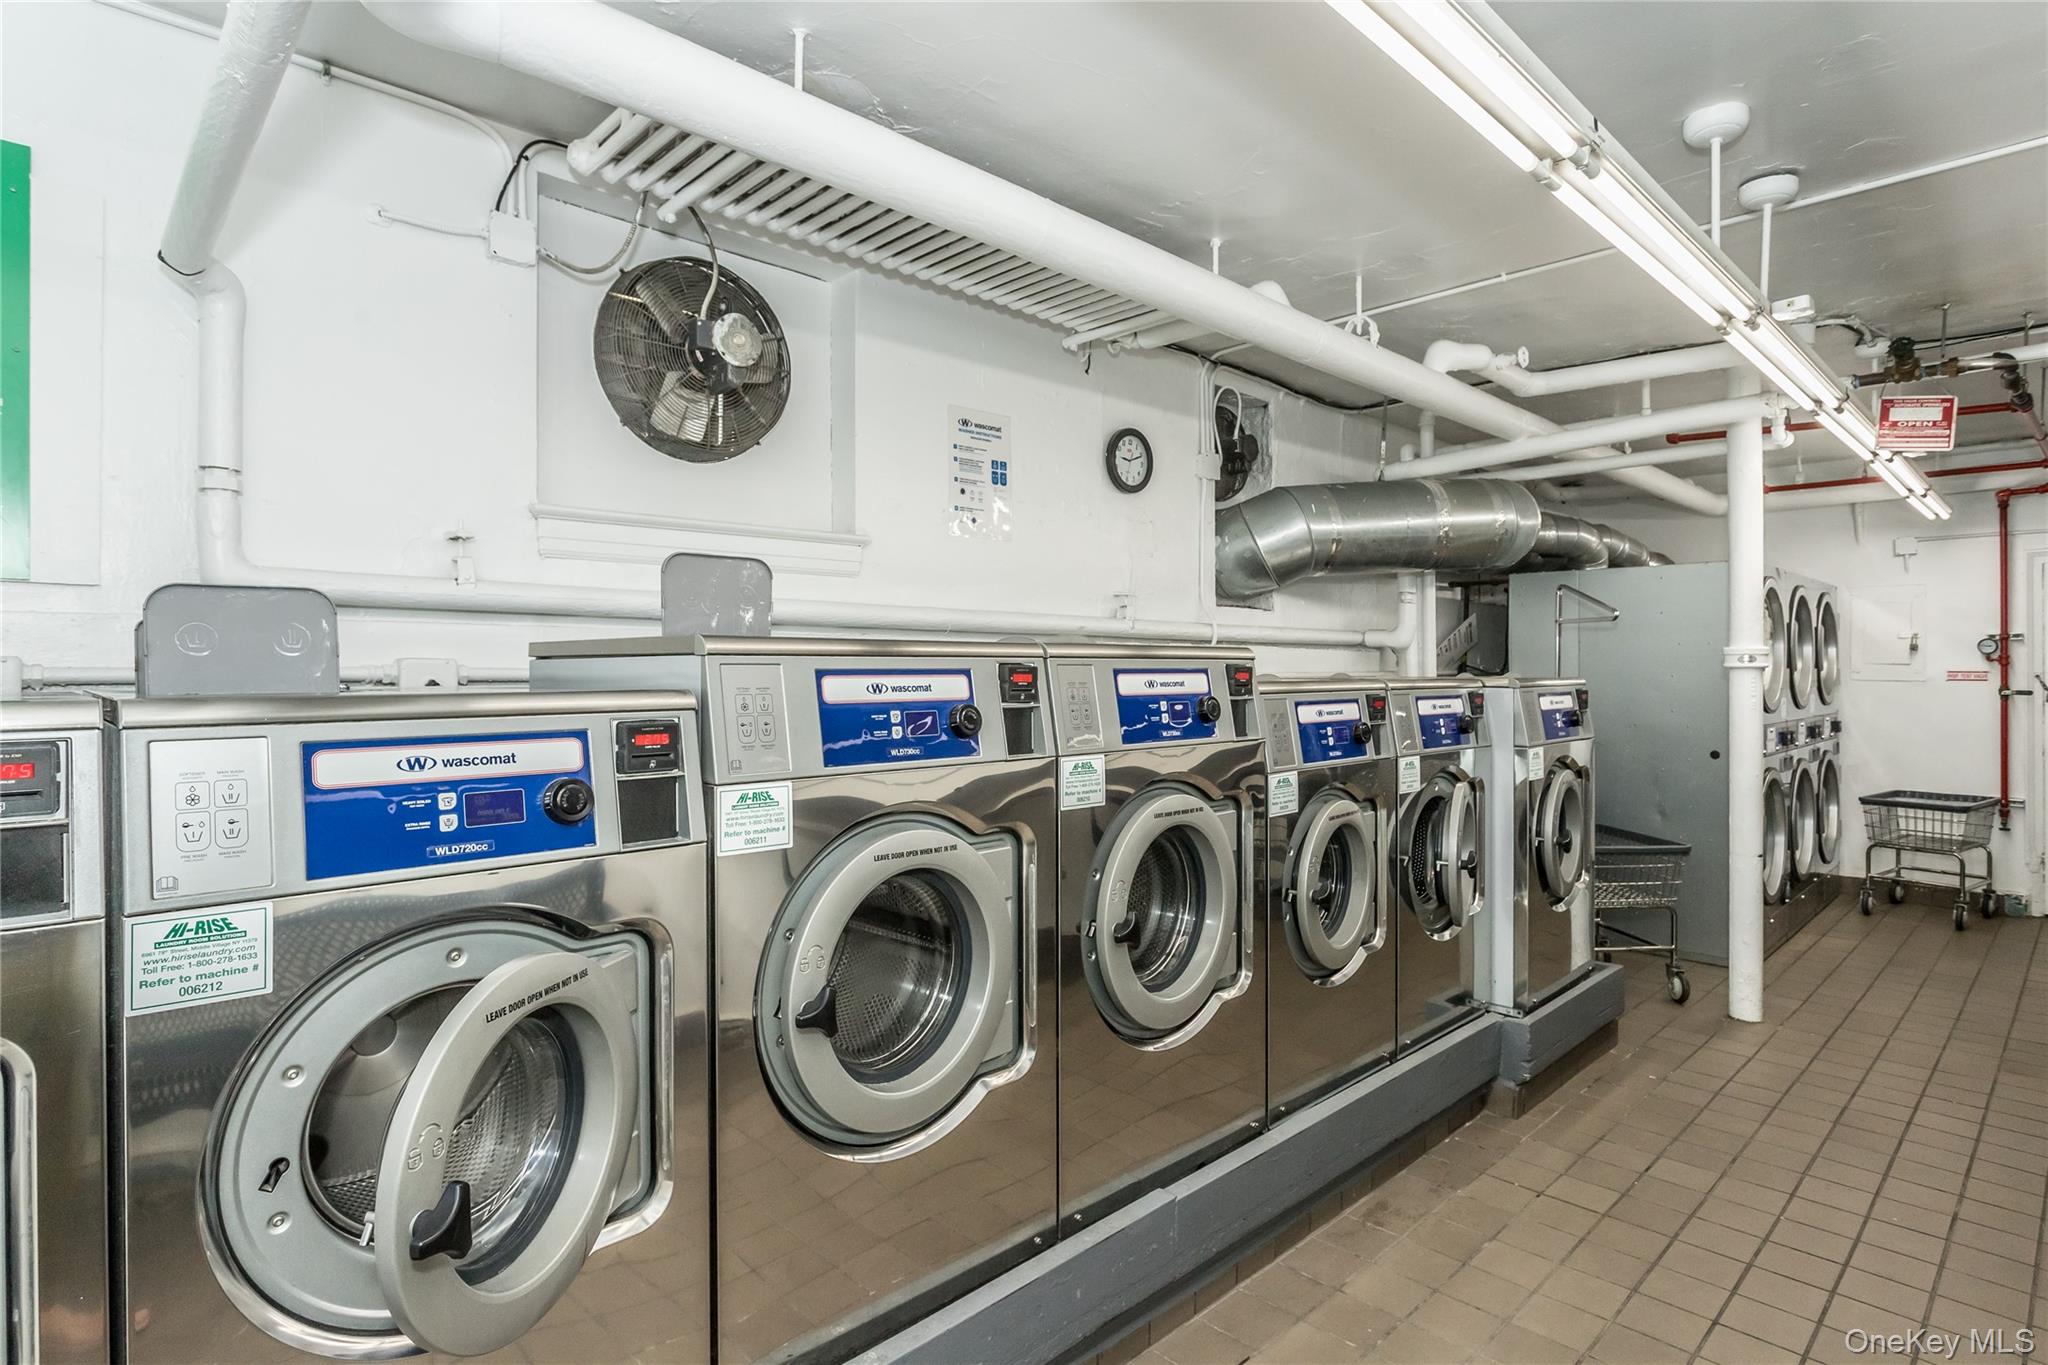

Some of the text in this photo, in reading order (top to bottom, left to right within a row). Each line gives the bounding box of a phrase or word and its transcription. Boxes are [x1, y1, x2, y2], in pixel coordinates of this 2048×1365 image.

[974, 422, 1002, 433] wascomat
[891, 683, 932, 693] wascomat
[441, 752, 517, 769] wascomat
[736, 790, 775, 804] HI-RISE
[724, 830, 743, 838] Refer
[752, 826, 781, 835] machine
[435, 843, 489, 856] WLD720cc
[873, 853, 891, 862] LEAVE
[891, 851, 905, 860] DOOR
[905, 849, 919, 858] OPEN
[919, 847, 933, 856] WHEN
[163, 917, 239, 940] HI-RISE
[155, 931, 246, 949] LAUNDRY ROOM SOLUTIONS
[141, 953, 258, 976] Toll Free: 1-800-278-1633
[143, 945, 256, 967] www.hiriselaundry.com
[139, 963, 260, 990] Refer to machine #
[178, 981, 224, 998] 006212
[485, 967, 589, 1024] LEAVE DOOR OPEN WHEN NOT IN USE
